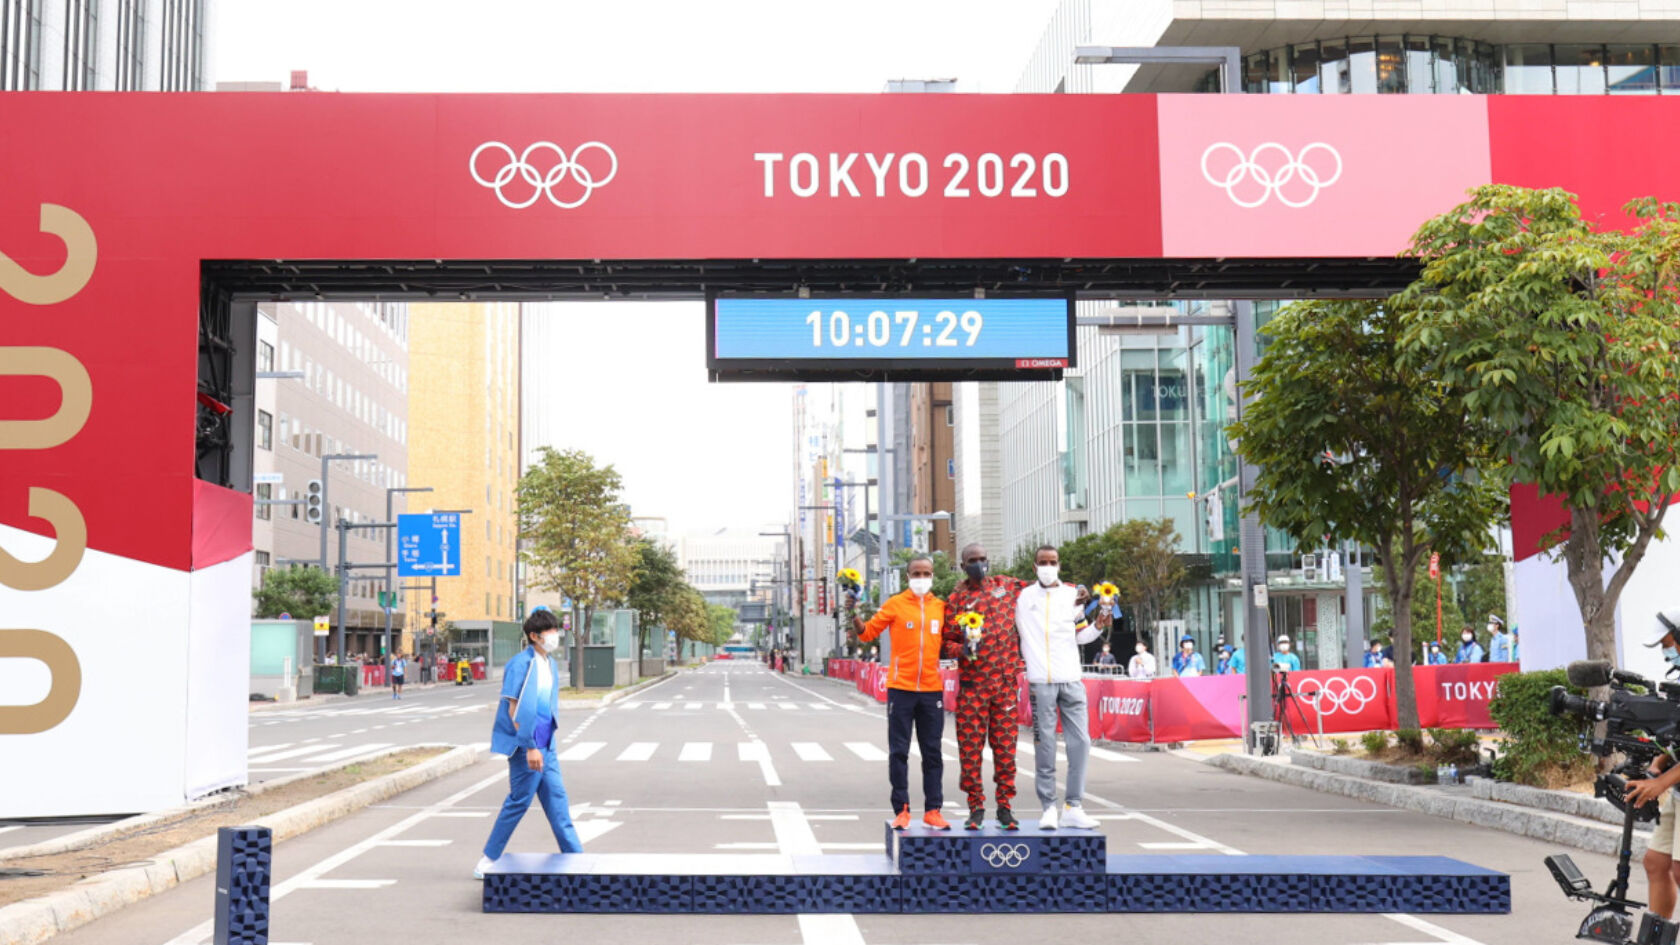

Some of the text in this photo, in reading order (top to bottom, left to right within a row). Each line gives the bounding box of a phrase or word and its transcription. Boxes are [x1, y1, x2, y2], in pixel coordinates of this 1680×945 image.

[753, 152, 1070, 198] TOKYO 2020
[805, 310, 984, 347] 10:07:29
[1031, 359, 1062, 367] OMEGA
[1441, 681, 1504, 702] TOKY
